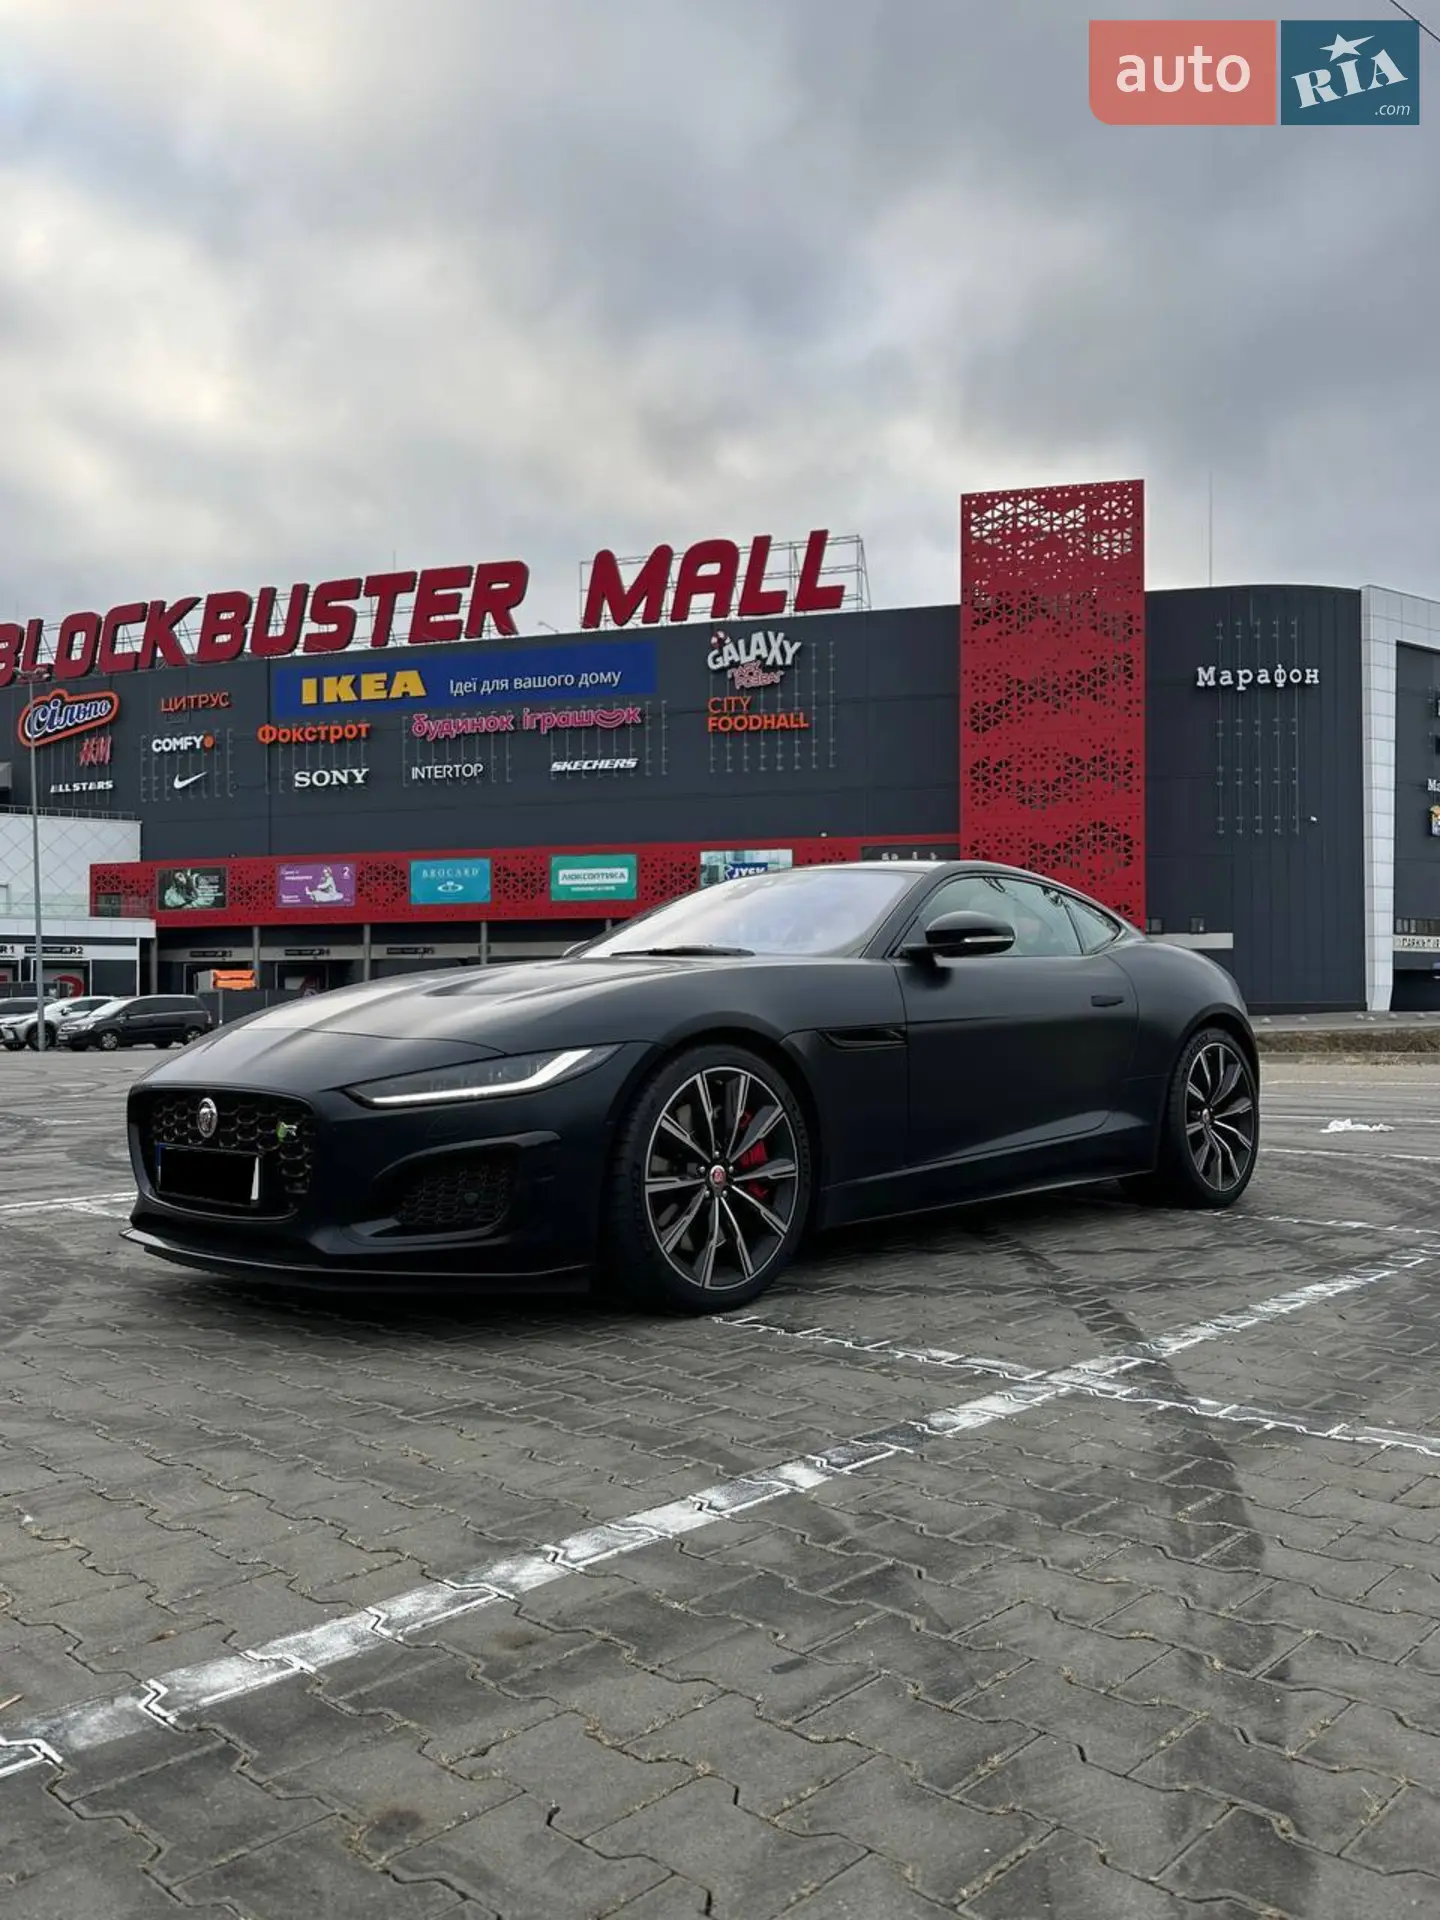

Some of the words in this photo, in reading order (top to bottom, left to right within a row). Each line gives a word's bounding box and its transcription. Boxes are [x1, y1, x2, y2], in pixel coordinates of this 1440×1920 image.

[580, 528, 845, 629] MALL
[707, 630, 802, 671] GALAXY
[301, 669, 427, 705] IKEA
[449, 677, 477, 697] Ідеї
[480, 678, 509, 695] для
[513, 673, 575, 690] вашого
[578, 670, 622, 688] дому
[1195, 663, 1320, 691] Марафон
[161, 691, 230, 713] ЦИТРУС
[707, 695, 752, 714] CITY
[411, 713, 515, 742] будинок
[707, 711, 810, 733] FOODHALL
[151, 734, 205, 753] COMFY
[256, 723, 371, 745] Фокстрот
[411, 763, 484, 780] INTERTOP
[550, 758, 640, 772] SKECHERS
[293, 767, 370, 788] SONY
